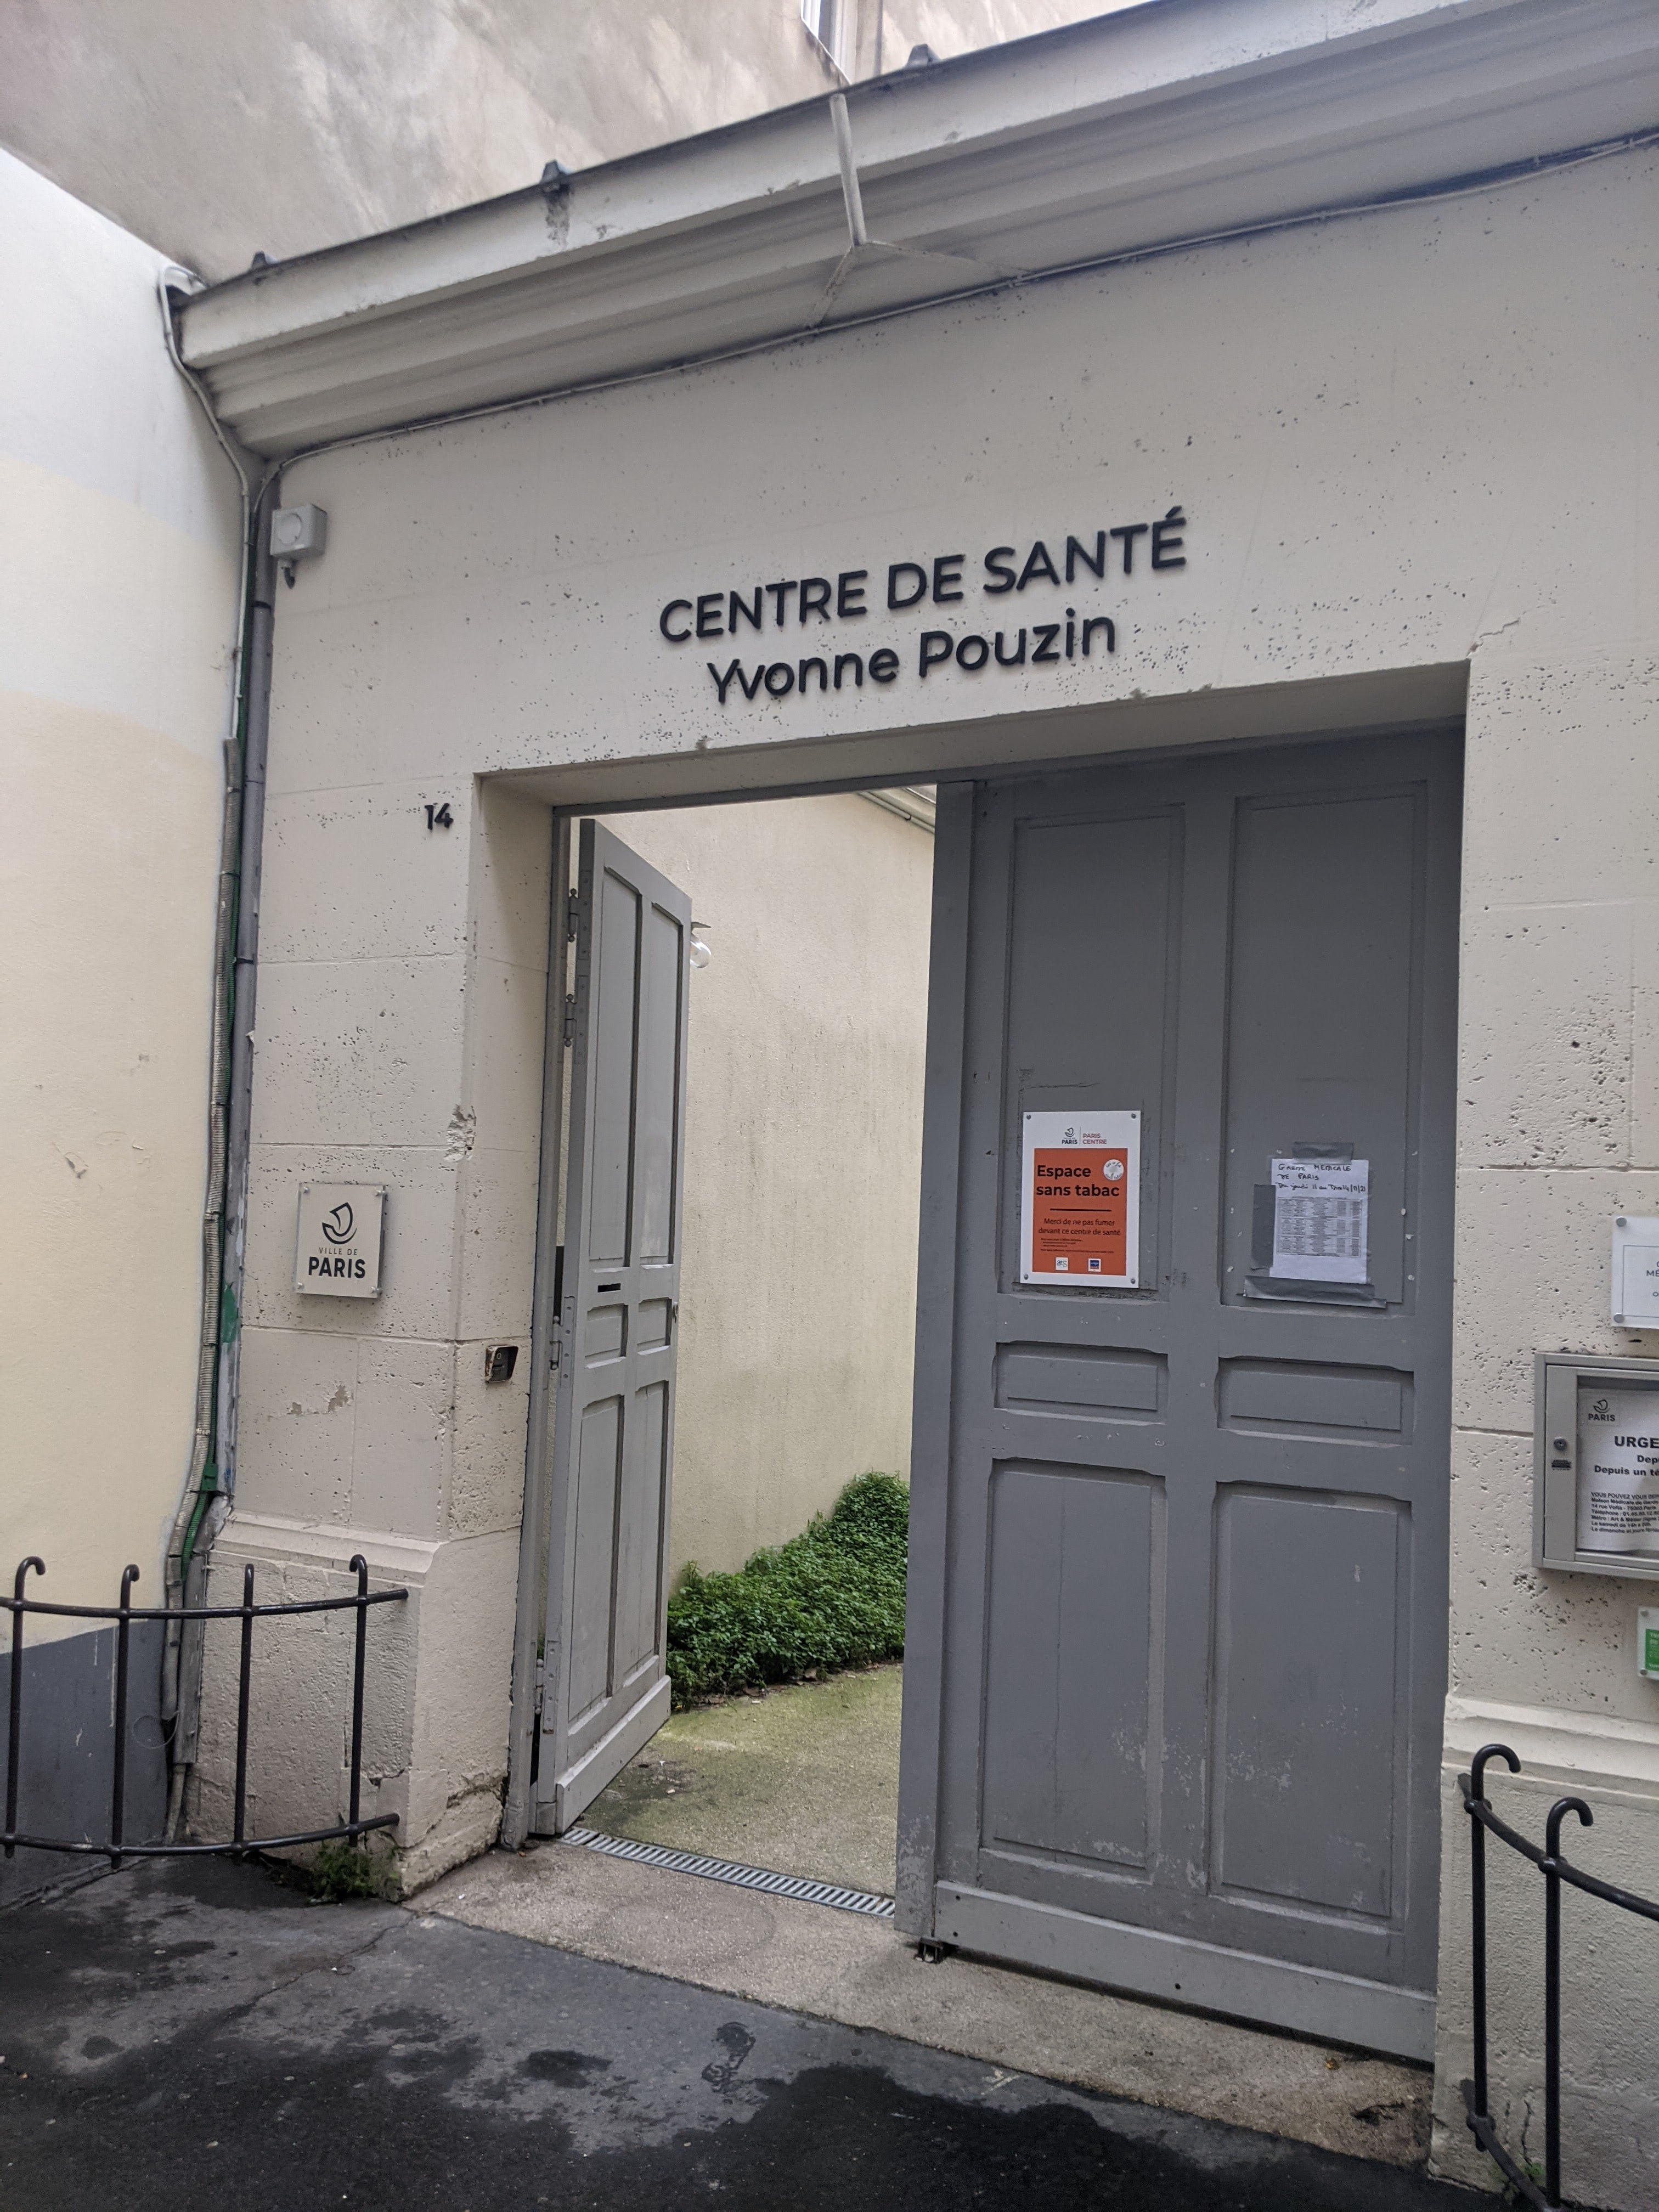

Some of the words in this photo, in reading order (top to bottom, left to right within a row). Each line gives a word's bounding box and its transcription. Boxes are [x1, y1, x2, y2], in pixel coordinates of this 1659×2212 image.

[659, 569, 867, 642] CENTRE
[887, 554, 964, 610] DE
[983, 505, 1187, 595] SANTÉ
[706, 647, 900, 703] Yvonne
[918, 608, 1115, 678] Pouzin
[424, 803, 454, 831] 14
[1037, 1165, 1091, 1180] Espace
[1036, 1186, 1071, 1196] sans
[1075, 1184, 1120, 1197] tabac
[319, 1247, 342, 1255] VILLE
[308, 1256, 366, 1279] PARIS
[1588, 1413, 1615, 1421] PARIS
[1614, 1436, 1659, 1448] URGE
[1637, 1454, 1659, 1465] Dep
[1594, 1465, 1629, 1475] Depuis
